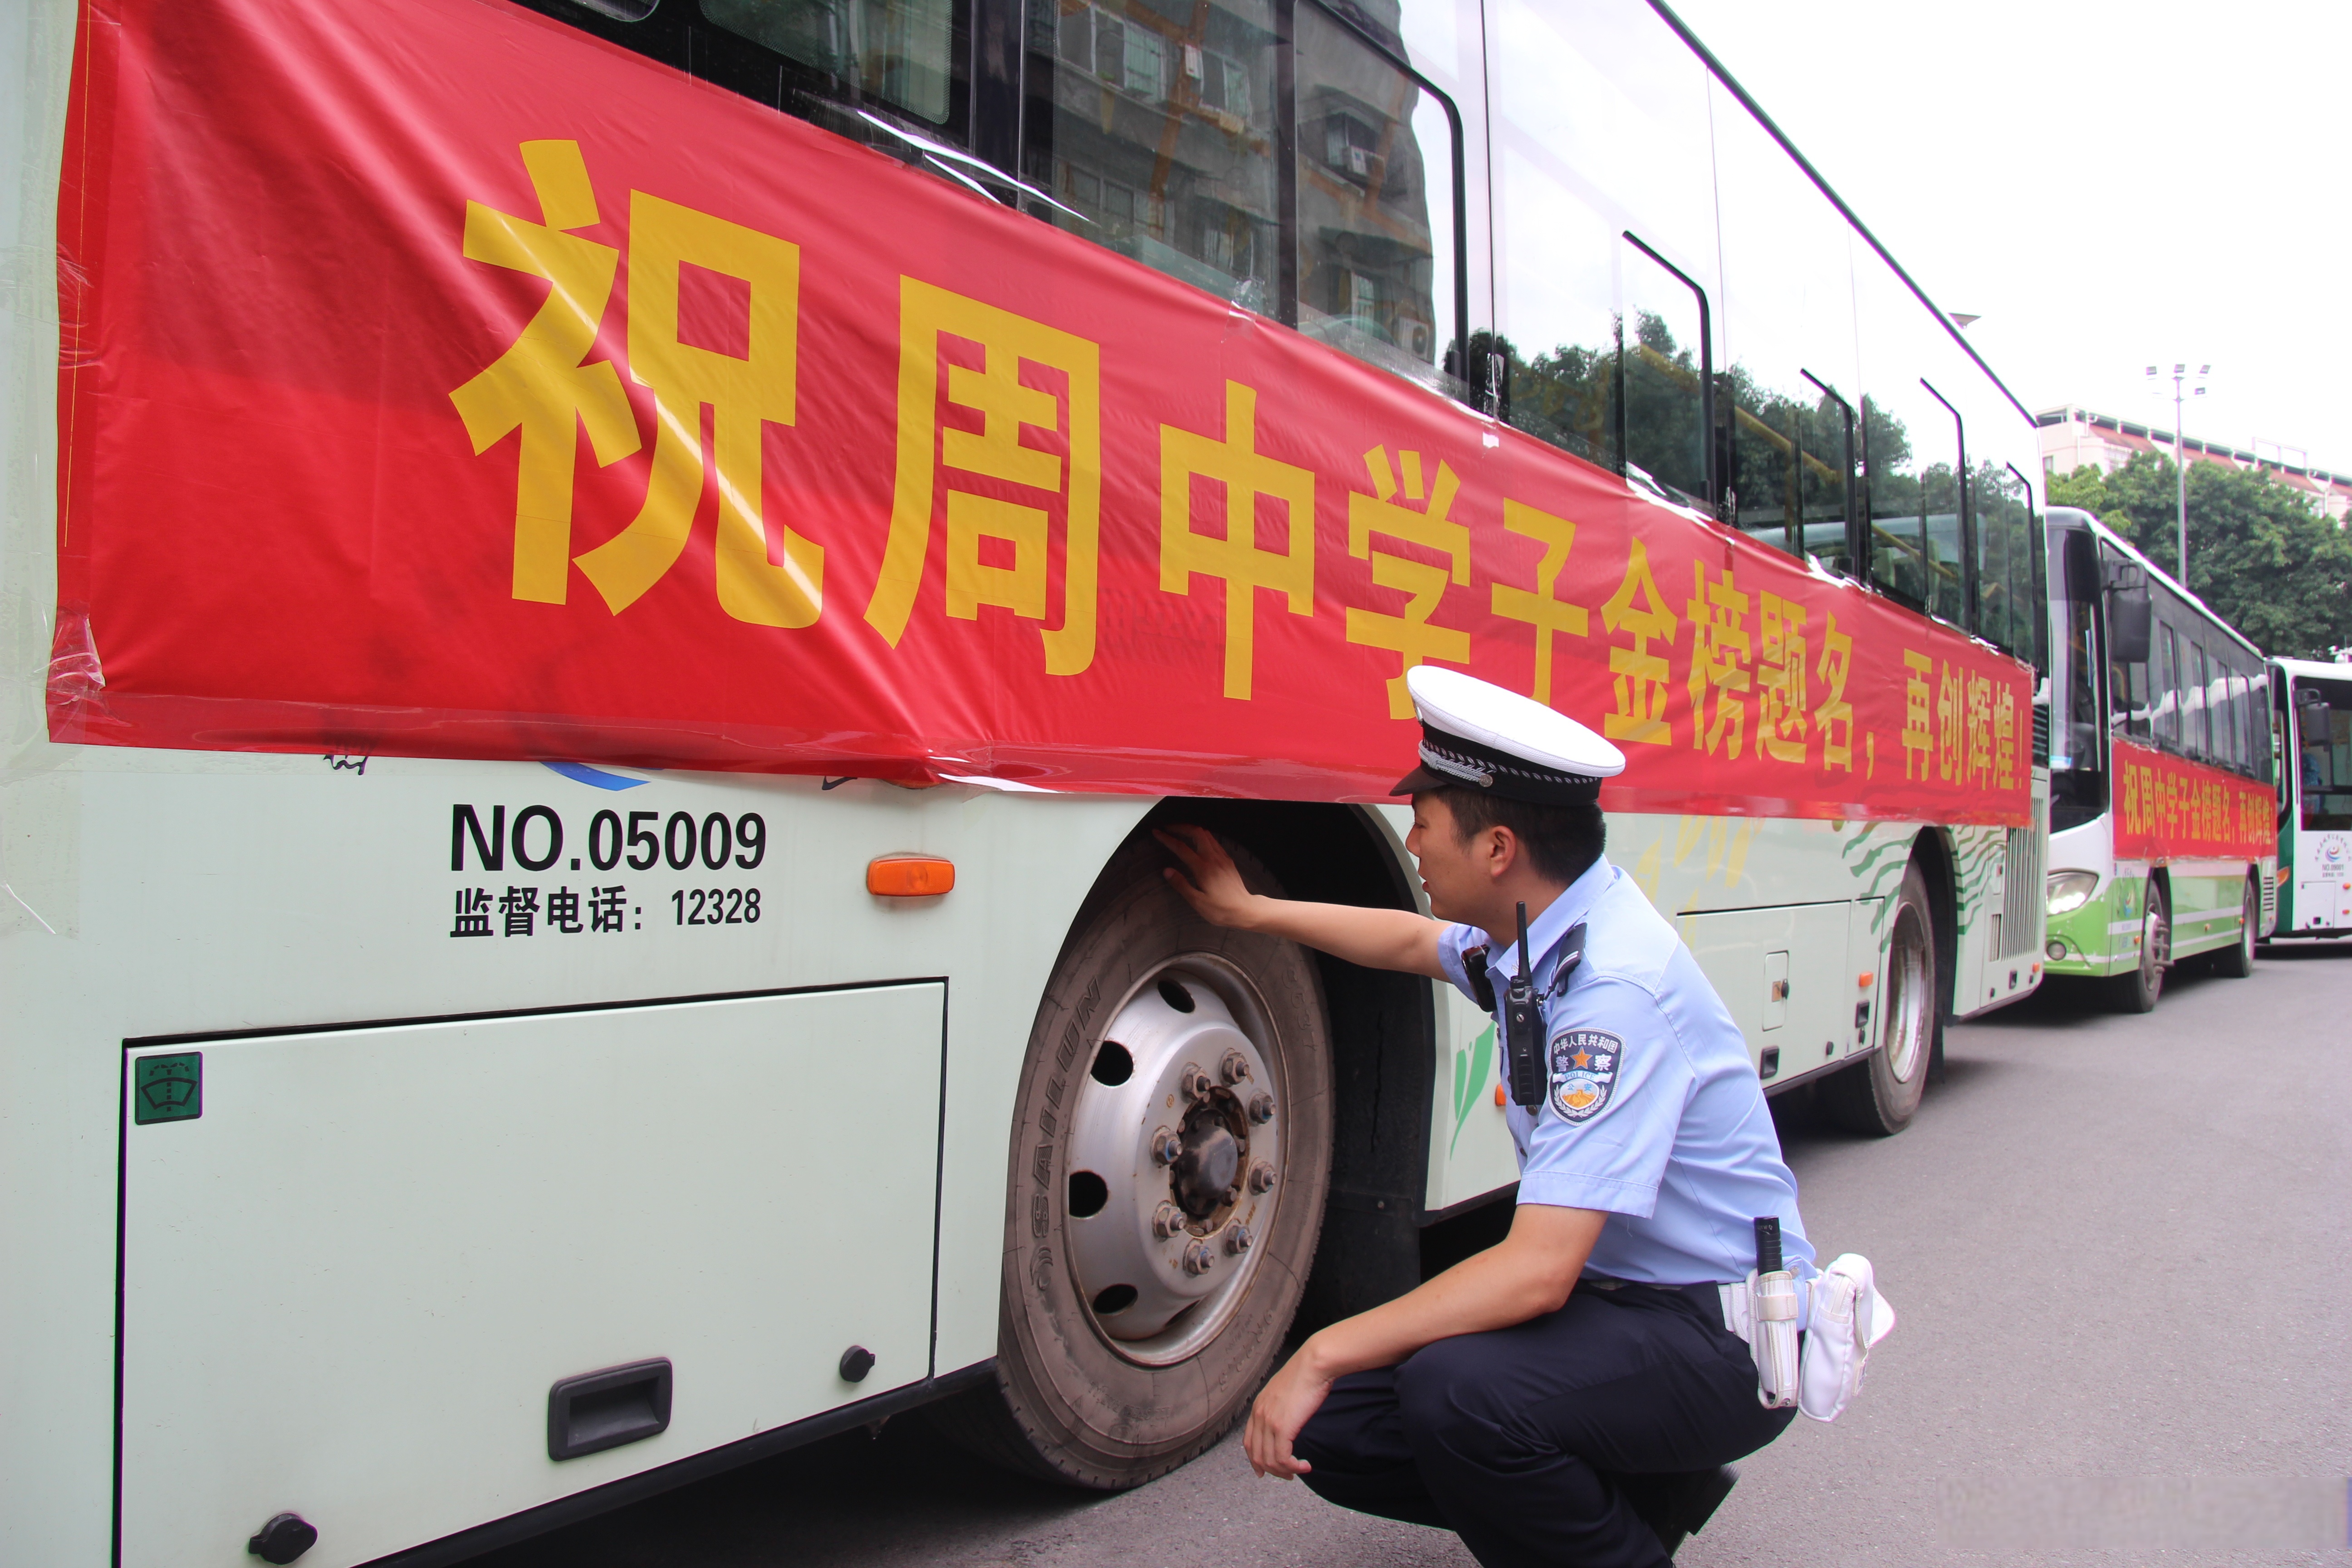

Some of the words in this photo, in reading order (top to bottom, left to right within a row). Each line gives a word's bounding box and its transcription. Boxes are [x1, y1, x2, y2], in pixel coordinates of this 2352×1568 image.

[448, 139, 2023, 791] 祝周中学子金榜题名，再创辉煌！
[451, 804, 766, 872] NO.05009
[671, 887, 762, 926] 12328
[1553, 1034, 1619, 1055] 中华人民共和国
[1565, 1069, 1596, 1081] POLICE
[1032, 976, 1102, 1239] SAILUN
